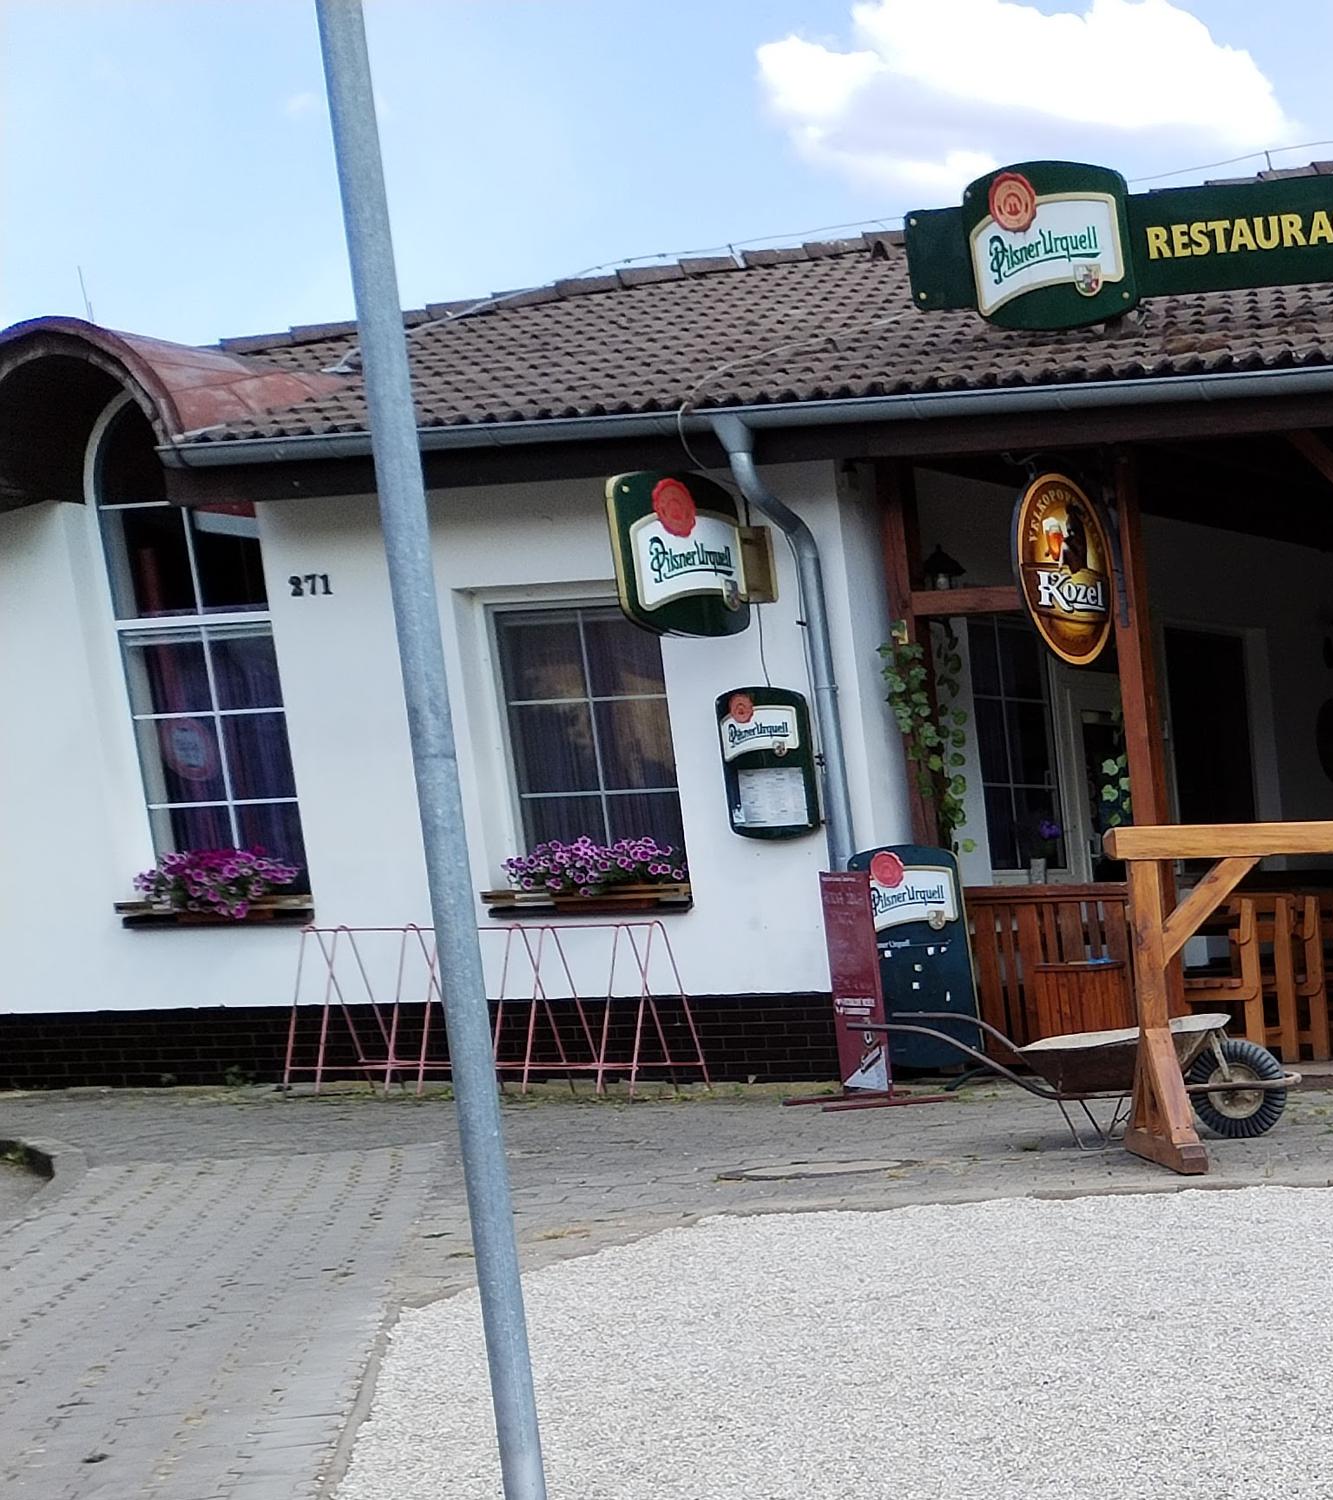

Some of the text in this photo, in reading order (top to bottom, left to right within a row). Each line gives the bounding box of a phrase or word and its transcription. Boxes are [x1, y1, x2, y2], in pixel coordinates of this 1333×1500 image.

[989, 228, 1099, 285] Pilsner Urquell
[649, 536, 732, 584] Pilsner Urquell
[288, 573, 334, 597] 271
[1036, 570, 1106, 612] Kozel
[755, 721, 789, 739] Urquell
[870, 886, 906, 917] Pilsner
[904, 884, 945, 906] Urquell
